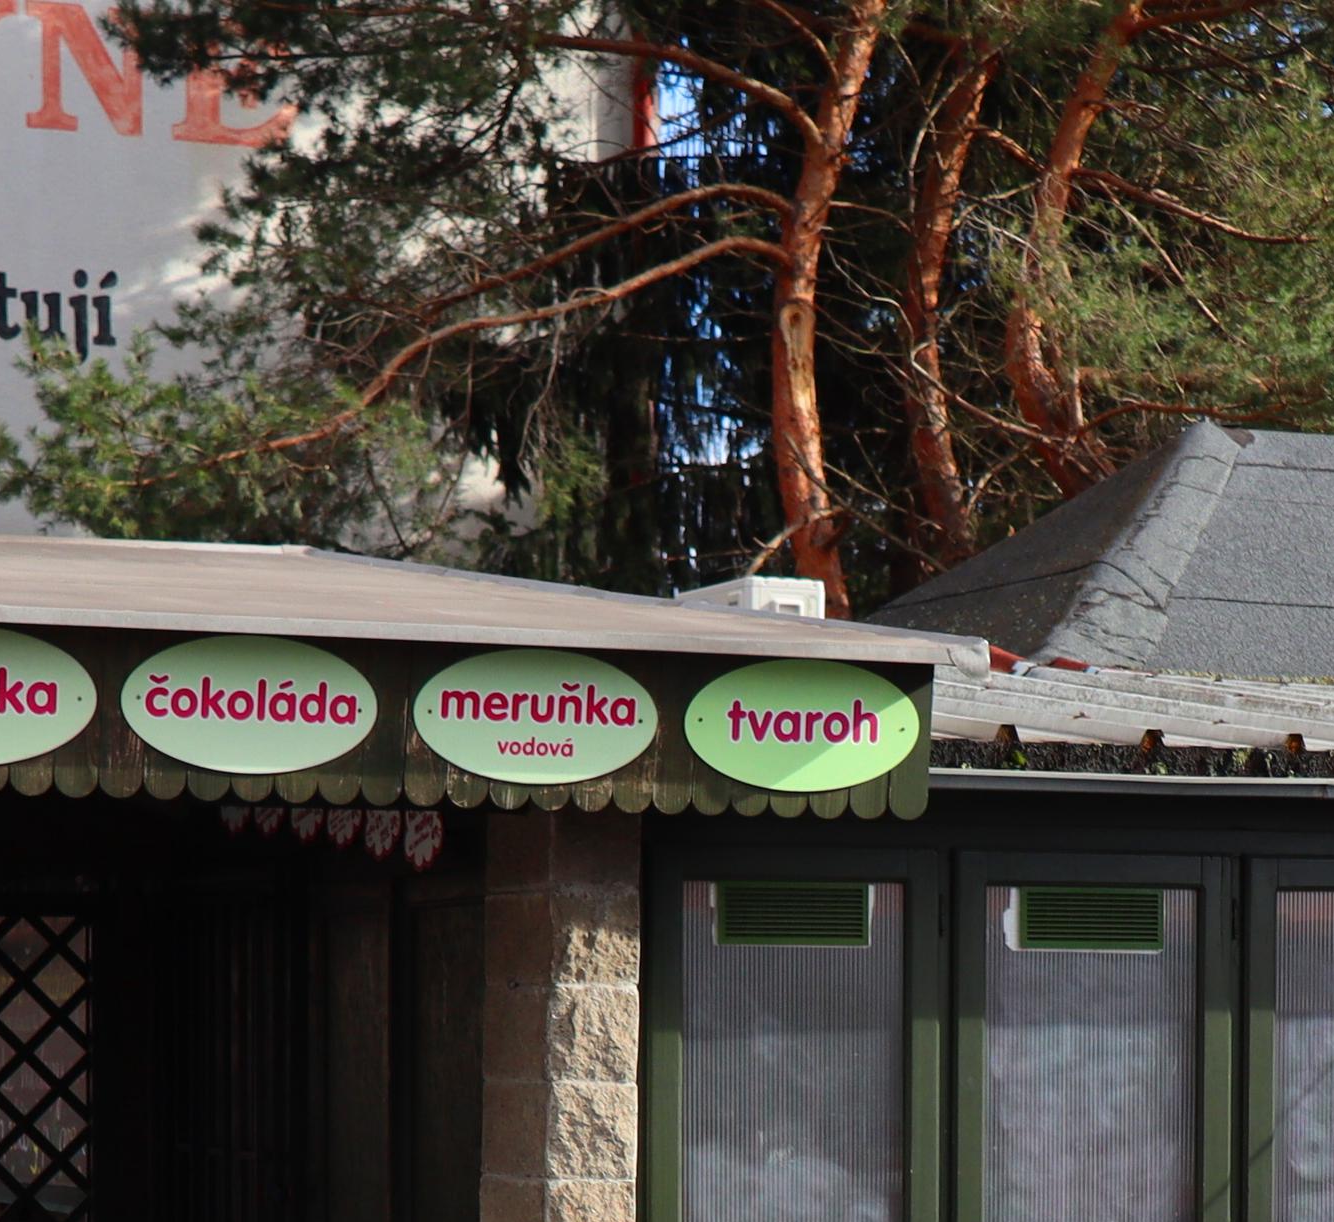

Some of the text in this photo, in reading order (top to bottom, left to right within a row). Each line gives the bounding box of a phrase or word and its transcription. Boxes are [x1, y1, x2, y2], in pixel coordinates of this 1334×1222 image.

[144, 674, 358, 725] čokoláda
[439, 682, 636, 727] meruňka
[727, 699, 879, 743] tvaroh
[498, 738, 574, 757] vodová
